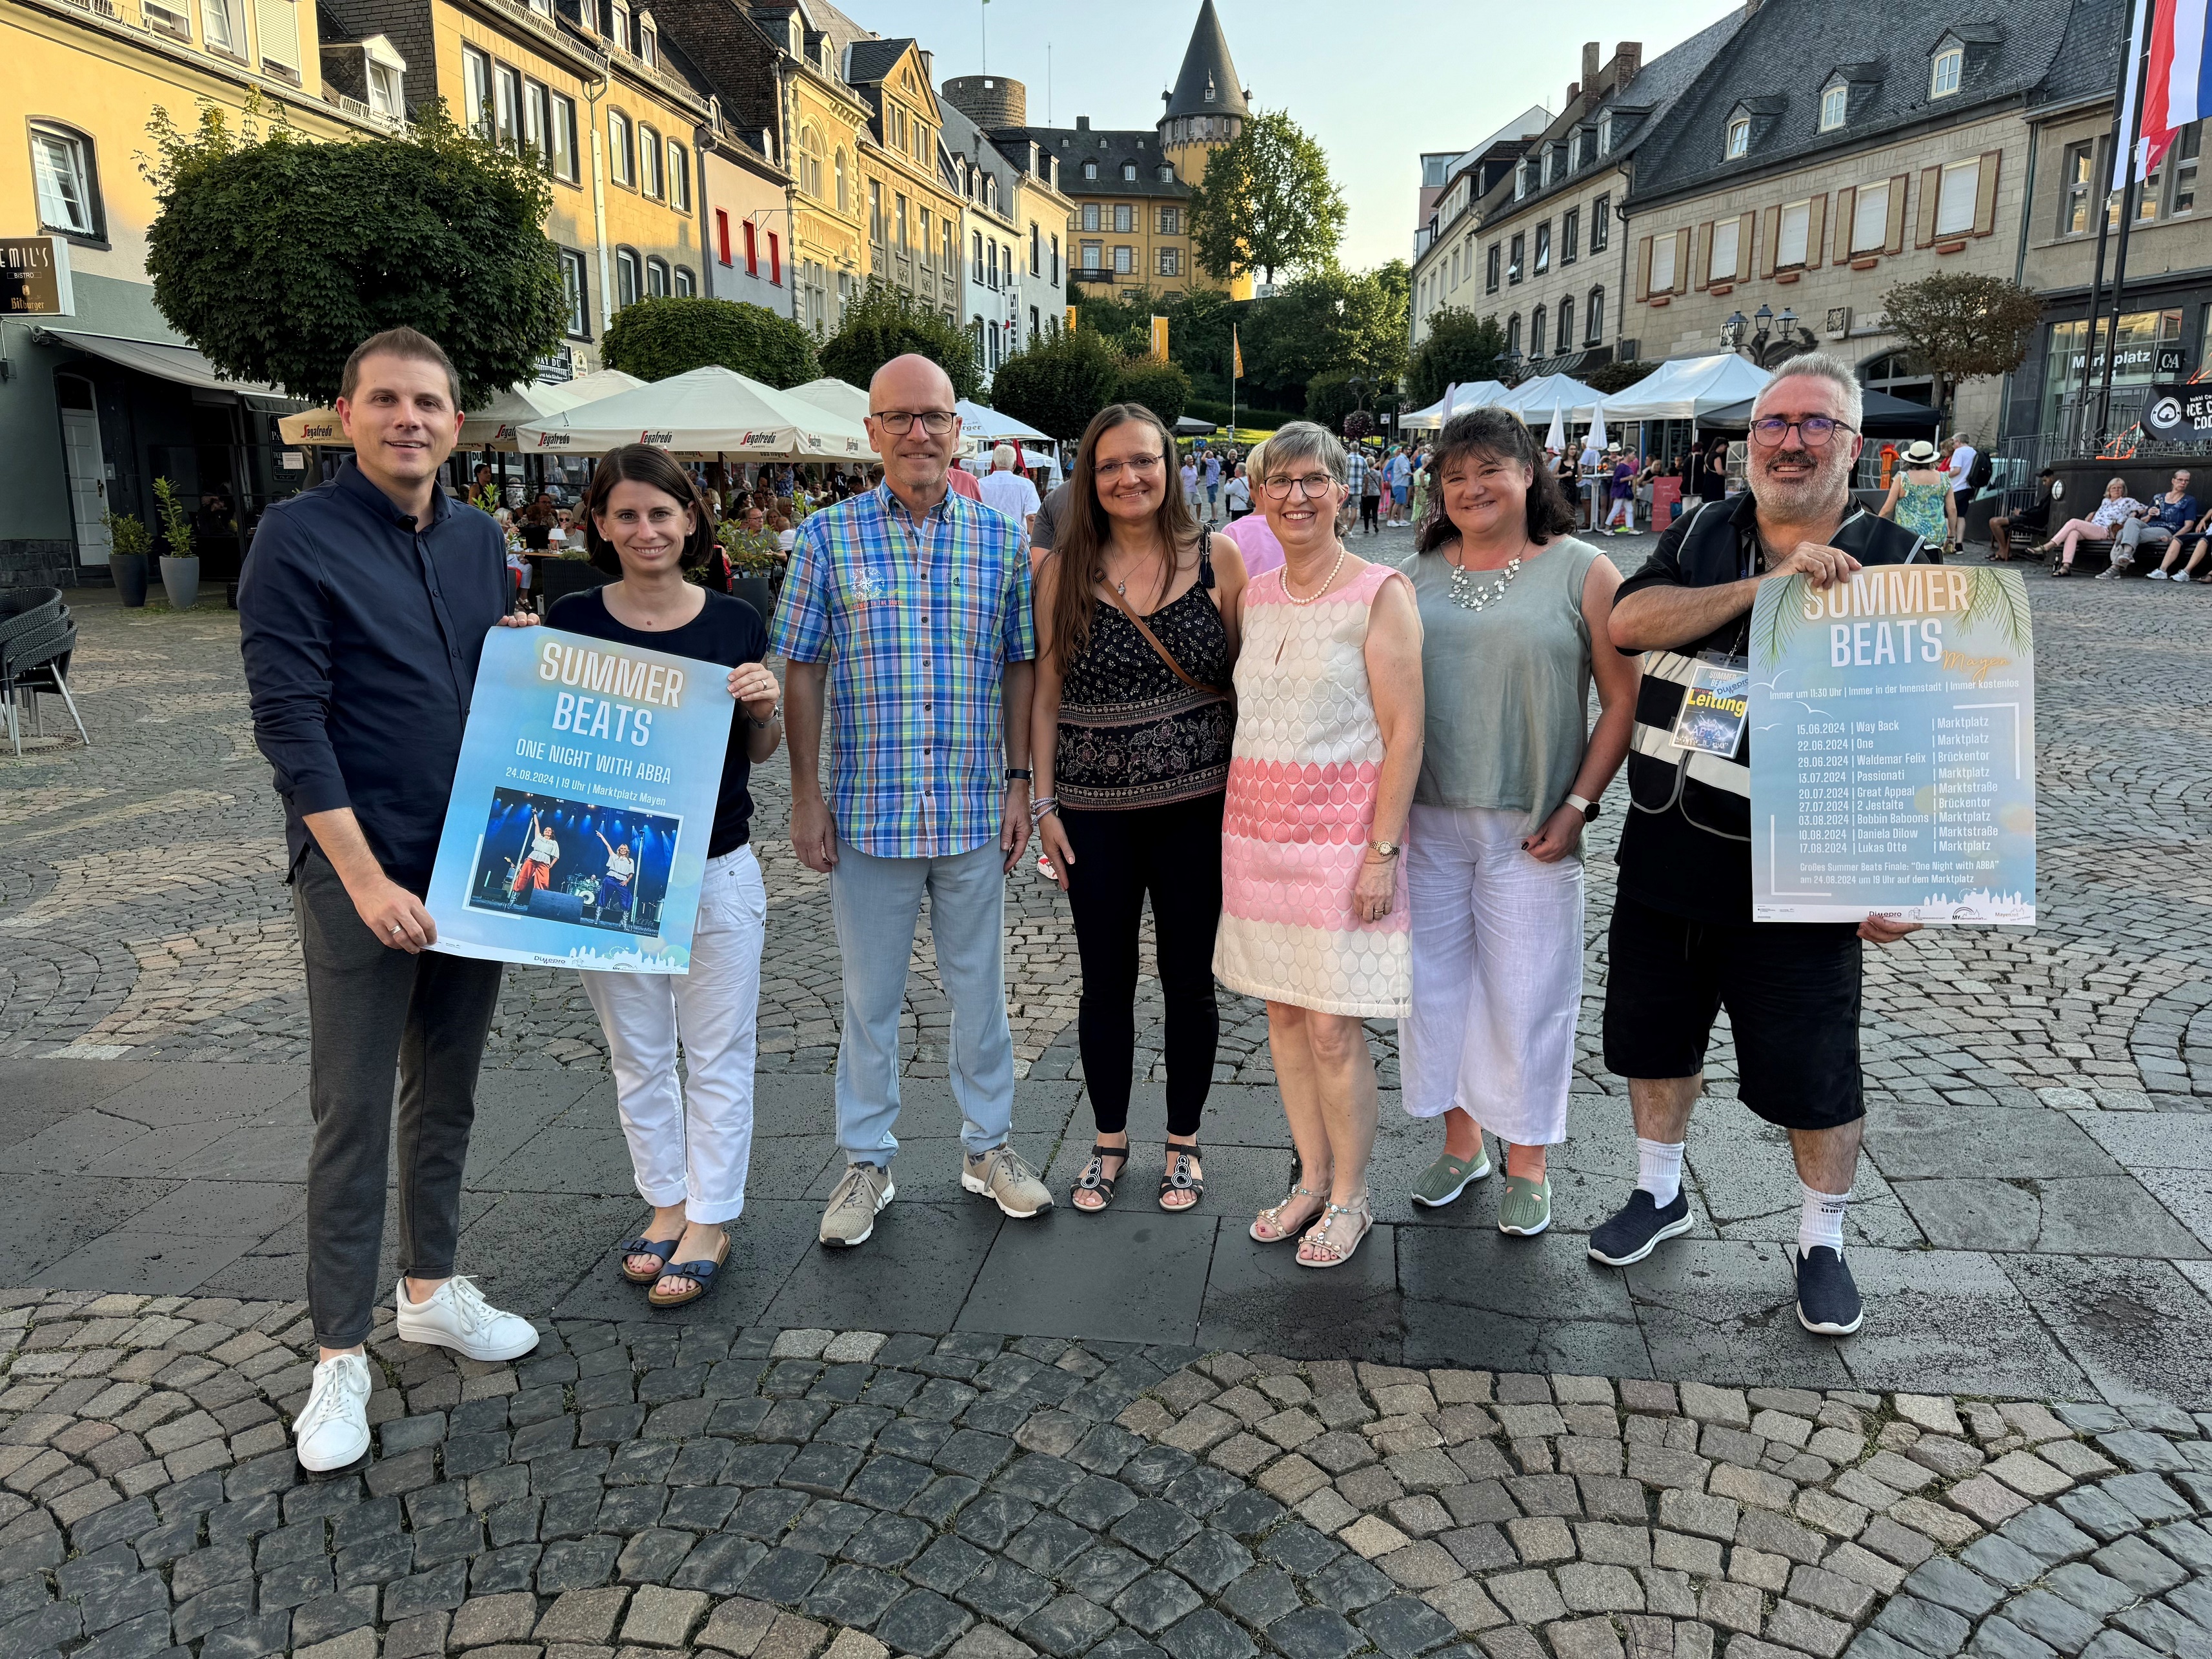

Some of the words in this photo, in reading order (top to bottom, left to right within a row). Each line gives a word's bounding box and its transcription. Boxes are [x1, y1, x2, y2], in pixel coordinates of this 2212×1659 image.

[11, 297, 45, 311] Bitburger
[552, 357, 561, 368] DU
[2072, 350, 2151, 368] Mrkplatz
[2162, 354, 2179, 368] C&A
[2186, 402, 2203, 417] ICE
[301, 424, 332, 439] Segafredo
[538, 432, 570, 447] Segafredo
[639, 430, 672, 445] Segafredo
[740, 431, 777, 445] Segafredo
[1804, 570, 1970, 620] SUMMER
[1830, 618, 1943, 667] BEATS
[1940, 649, 2012, 683] Mayen
[539, 642, 685, 708] SUMMER
[1770, 690, 1794, 700] Immer
[1796, 690, 1807, 699] um
[1810, 688, 1827, 698] 11:30
[1829, 687, 1842, 697] Uhr
[1849, 687, 1873, 696] Immer
[1876, 685, 1883, 694] in
[1885, 684, 1897, 694] der
[1900, 682, 1942, 693] Innenstadt
[1950, 681, 1976, 690] Immer
[1978, 678, 2019, 689] kostenlos
[1687, 689, 1747, 718] Leitung
[552, 691, 652, 747] BEATS
[1797, 722, 1845, 735] 15.06.2024
[1856, 721, 1875, 734] Way
[1878, 719, 1899, 731] Back
[1937, 716, 1989, 730] Marktplatz
[1798, 739, 1848, 751] 22.06.2024
[1856, 738, 1873, 749] One
[1938, 733, 1989, 747] Marktplatz
[516, 738, 546, 760] ONE
[548, 745, 592, 769] NIGHT
[596, 754, 633, 778] WITH
[635, 762, 671, 785] ABBA
[1798, 755, 1849, 768] 29.06.2024
[1857, 754, 1902, 765] Waldemar
[1905, 752, 1926, 763] Felix
[1938, 750, 1990, 763] Brückentor
[1798, 771, 1846, 784] 13.07.2024
[1857, 769, 1905, 781] Passionati
[1938, 767, 1990, 780] Marktplatz
[505, 767, 554, 785] 24.08.2024
[561, 778, 570, 789] 19
[572, 779, 587, 792] Uhr
[592, 783, 638, 801] Marktplatz
[639, 792, 666, 807] Mayen
[1799, 787, 1849, 799] 20.07.2024
[1857, 787, 1882, 798] Great
[1884, 785, 1915, 799] Appeal
[1939, 781, 1998, 794] Marktstraße
[1799, 800, 1849, 812] 27.07.2024
[1857, 800, 1863, 811] 2
[1865, 799, 1904, 810] Jestalte
[1939, 797, 1991, 809] Brückentor
[1798, 814, 1849, 826] 03.08.2024
[1857, 814, 1887, 824] Bobbin
[1890, 813, 1929, 824] Baboons
[1939, 811, 1991, 824] Marktplatz
[1799, 829, 1847, 840] 10.08.2024
[1858, 829, 1890, 840] Daniela
[1893, 828, 1918, 839] Dilow
[1939, 825, 1998, 838] Marktstraße
[1800, 843, 1847, 854] 17.08.2024
[1858, 842, 1884, 853] Lukas
[1887, 841, 1907, 852] Otte
[1939, 840, 1991, 853] Marktplatz
[1800, 863, 1825, 871] Großes
[1827, 863, 1858, 872] Summer
[1861, 862, 1882, 871] Beats
[1884, 861, 1909, 871] Finale:
[1932, 861, 1953, 872] Night
[1955, 861, 1974, 870] with
[1813, 875, 1856, 884] 24.08.2024
[1873, 875, 1880, 883] 19
[1882, 875, 1895, 884] Uhr
[1897, 874, 1910, 884] auf
[1912, 874, 1929, 883] dem
[1931, 874, 1974, 885] Marktplatz
